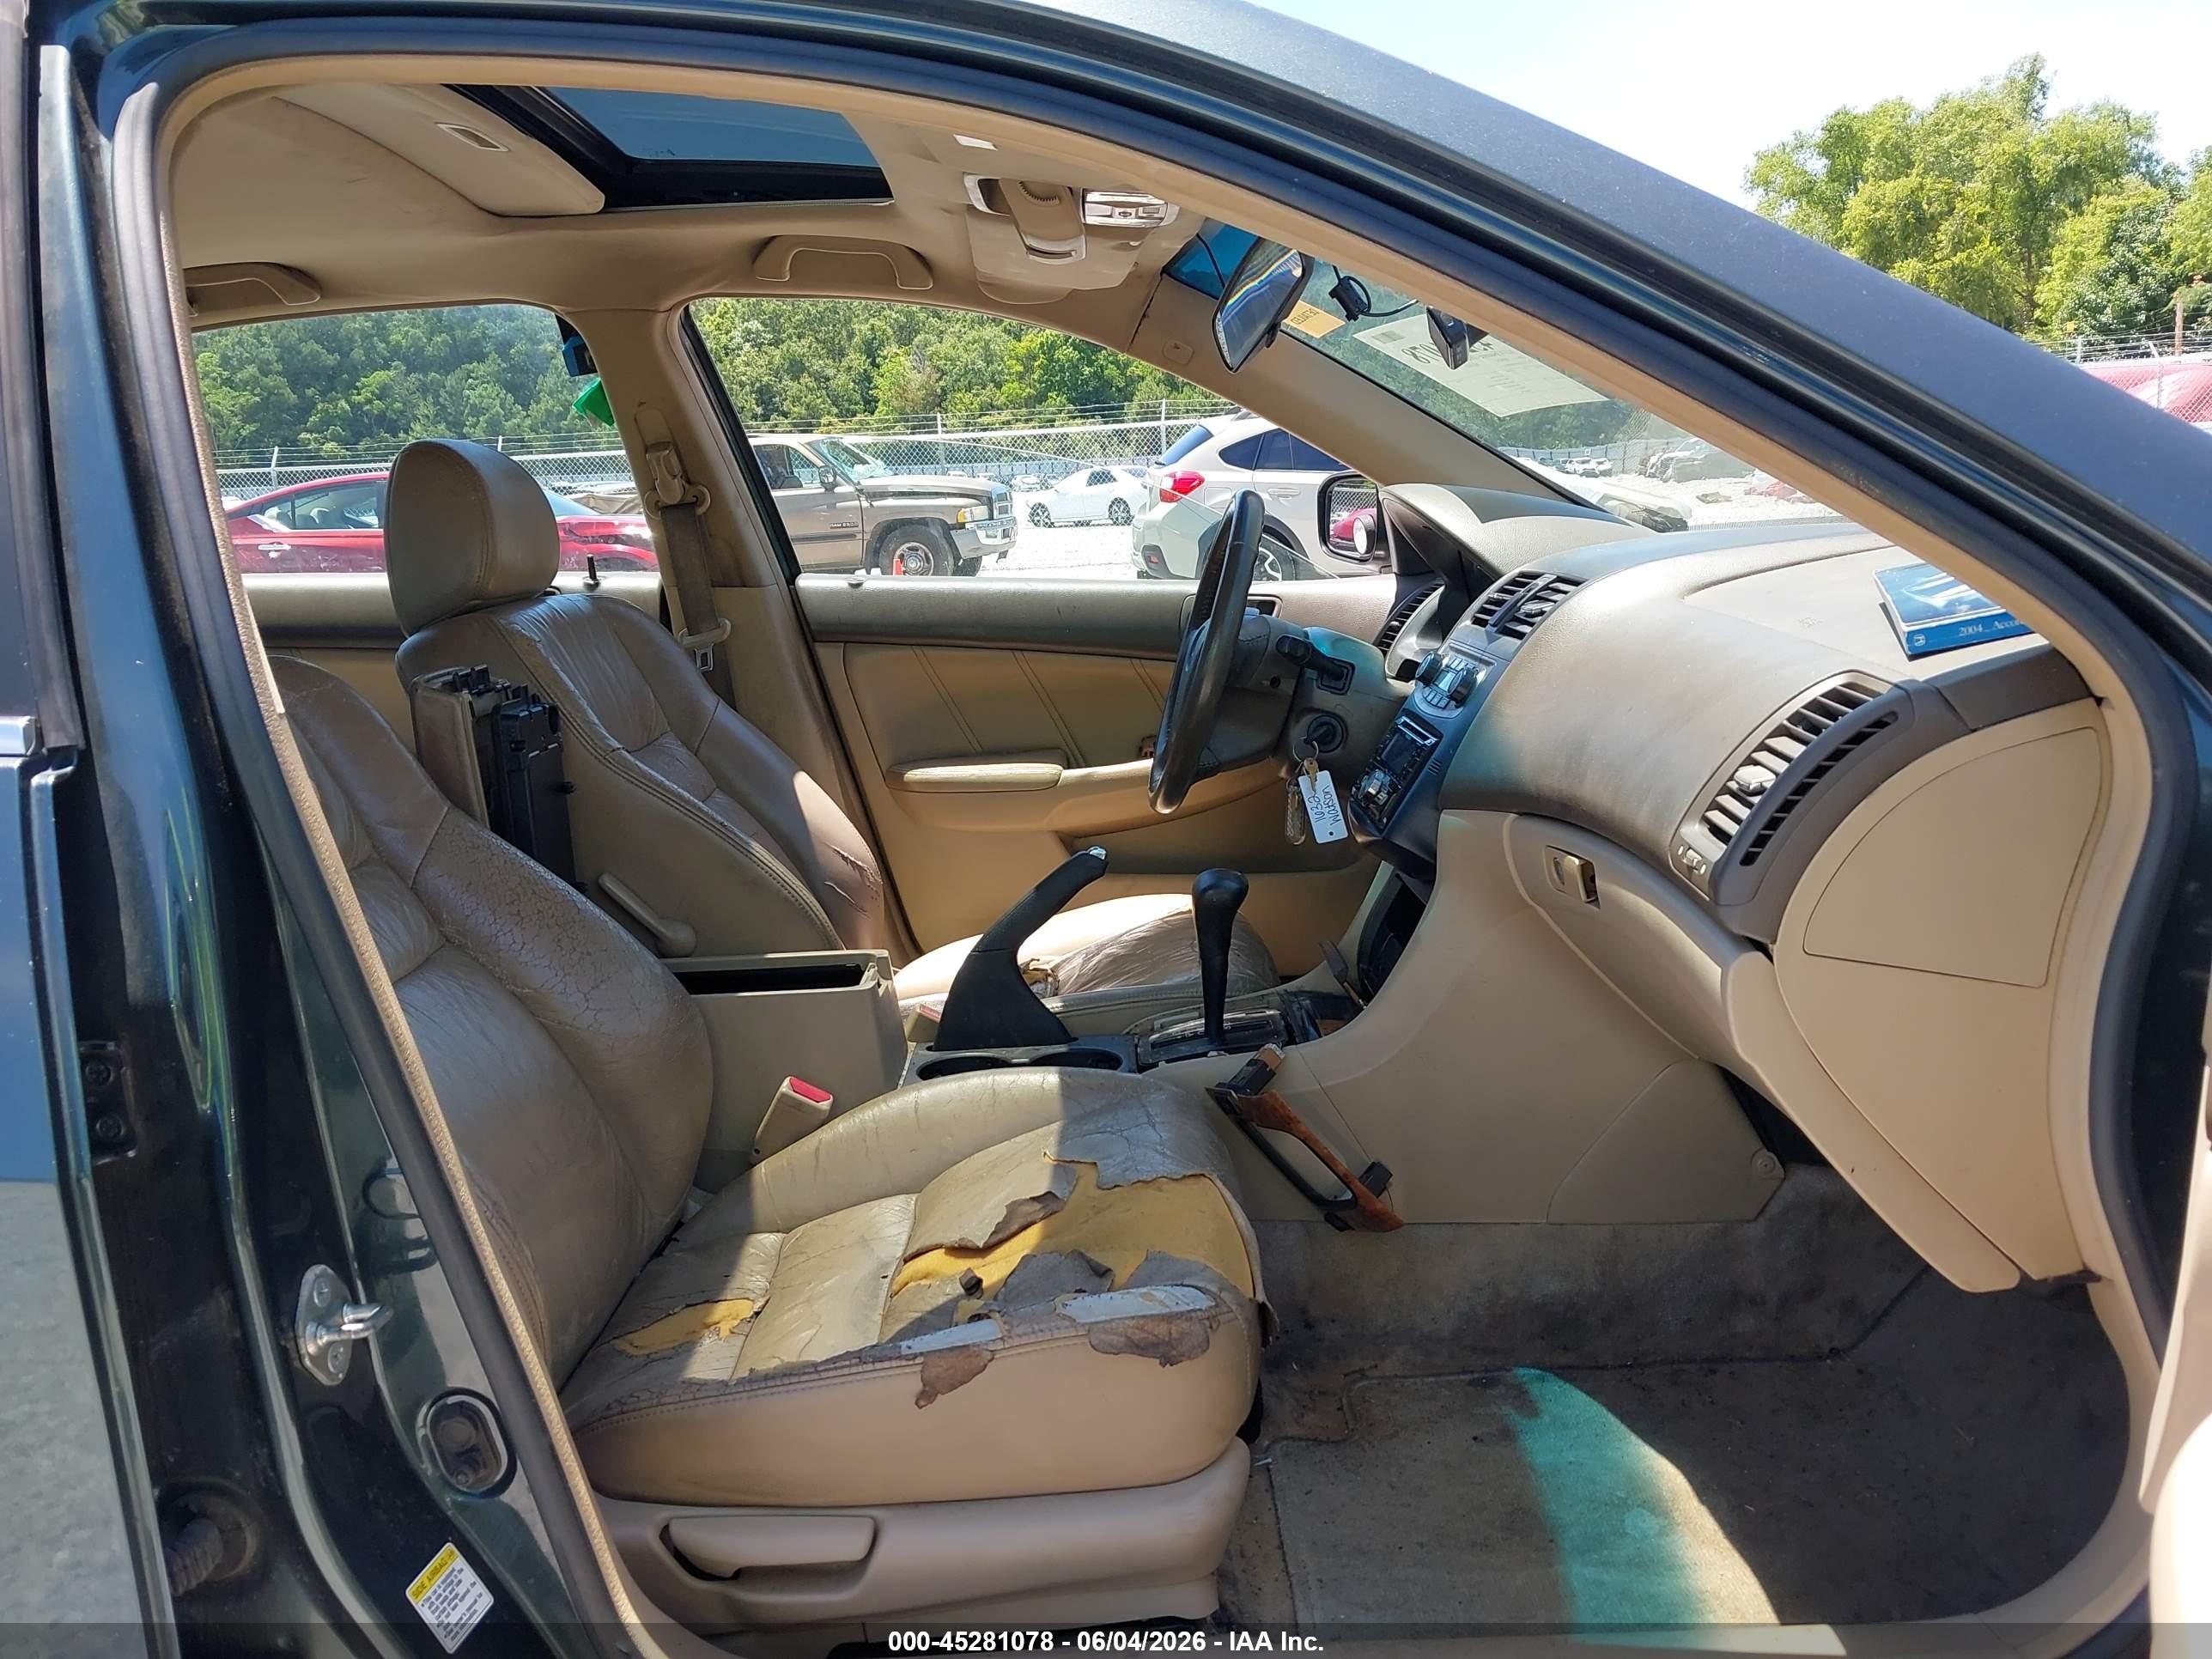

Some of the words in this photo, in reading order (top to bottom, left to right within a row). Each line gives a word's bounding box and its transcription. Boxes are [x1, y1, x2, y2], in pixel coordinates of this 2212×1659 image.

[1958, 623, 1984, 636] 2004
[1307, 792, 1328, 823] 1632
[411, 1580, 428, 1600] SIDE
[427, 1558, 449, 1583] AIRBAG
